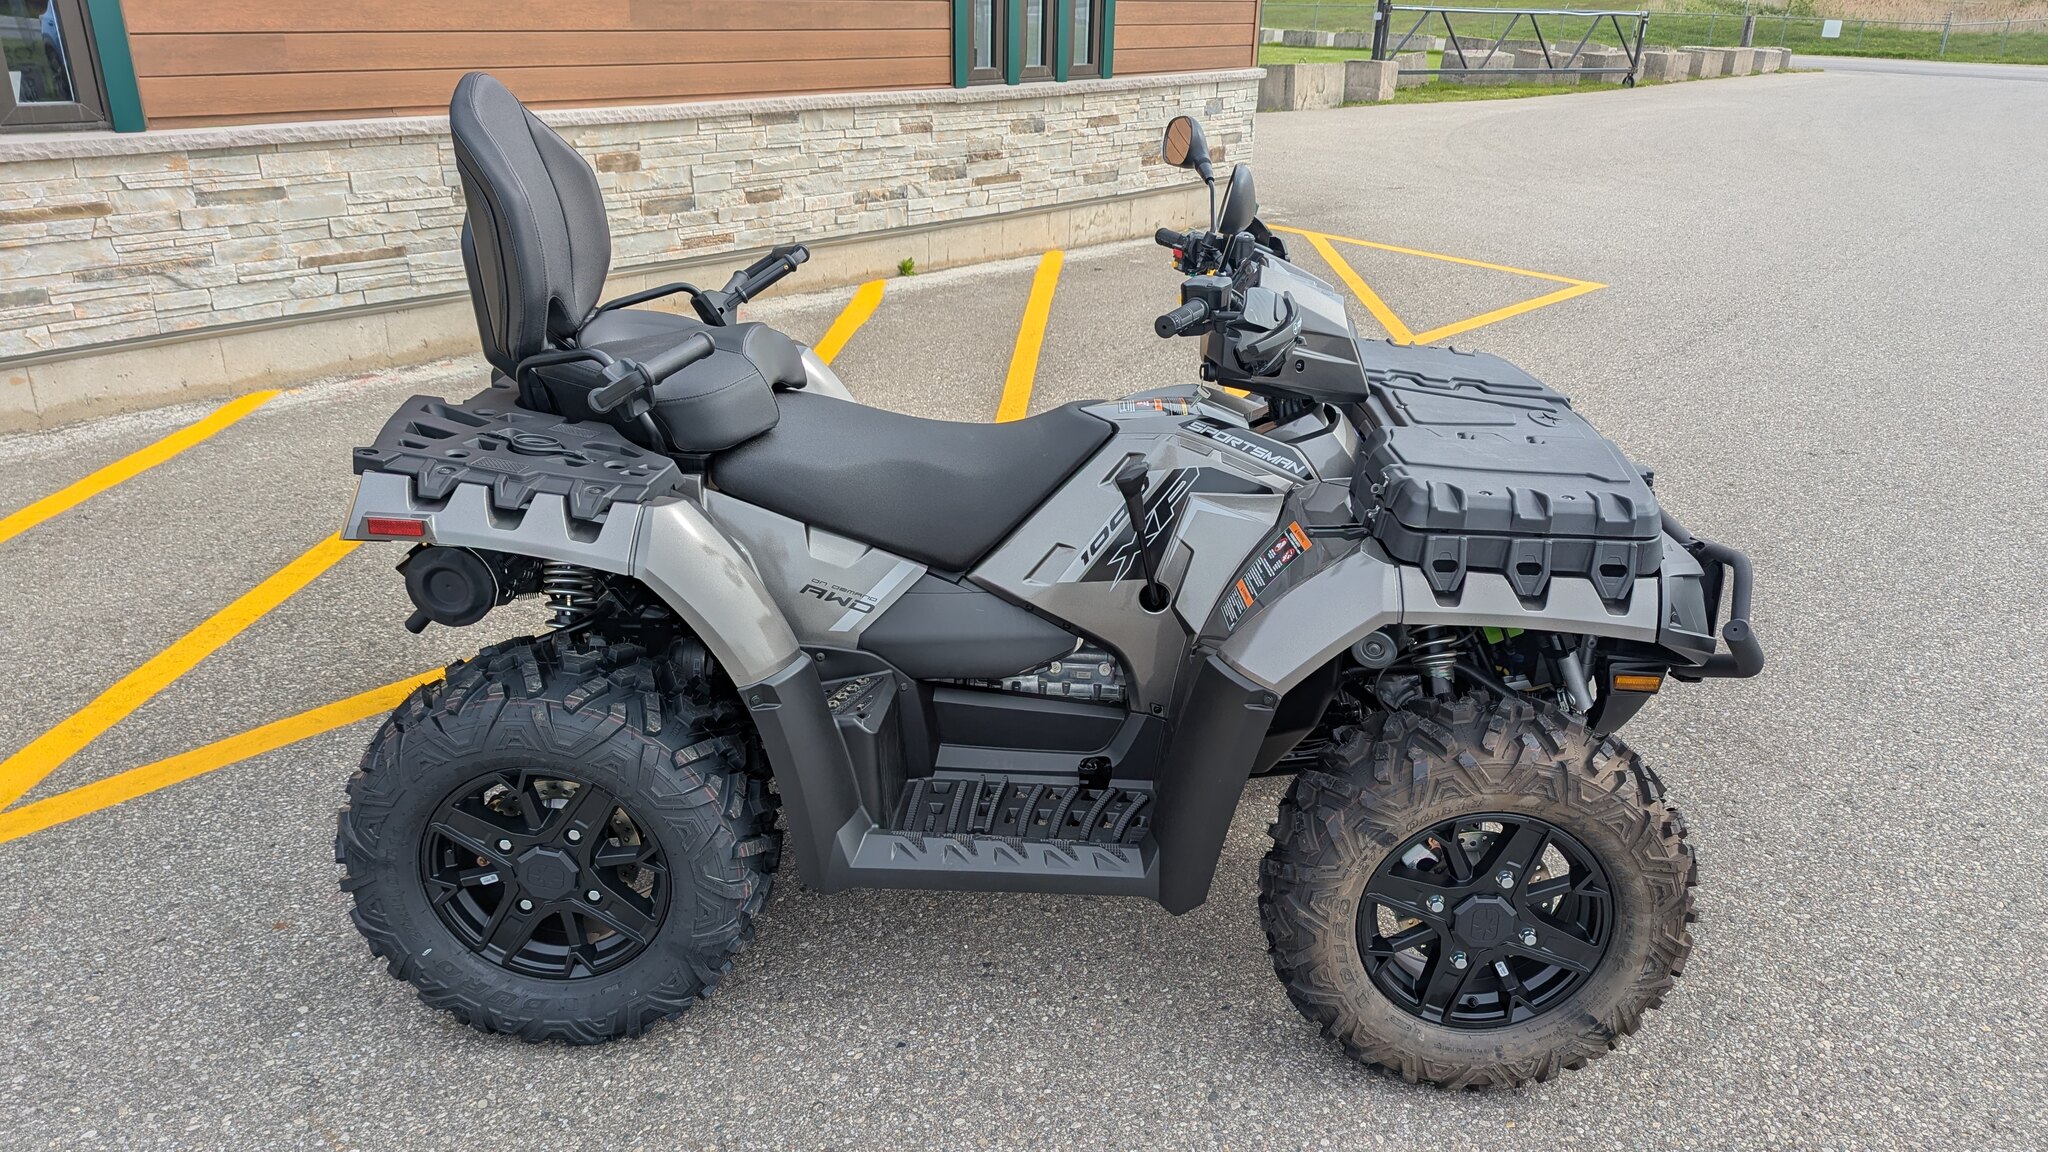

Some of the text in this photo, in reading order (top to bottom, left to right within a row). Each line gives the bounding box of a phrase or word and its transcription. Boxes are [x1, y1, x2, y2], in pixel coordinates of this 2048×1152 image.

[1187, 421, 1305, 474] SPORTSMAN
[1107, 465, 1200, 592] XP
[800, 584, 875, 613] AWD
[1334, 899, 1358, 987] DURO
[436, 960, 550, 1013] DURO
